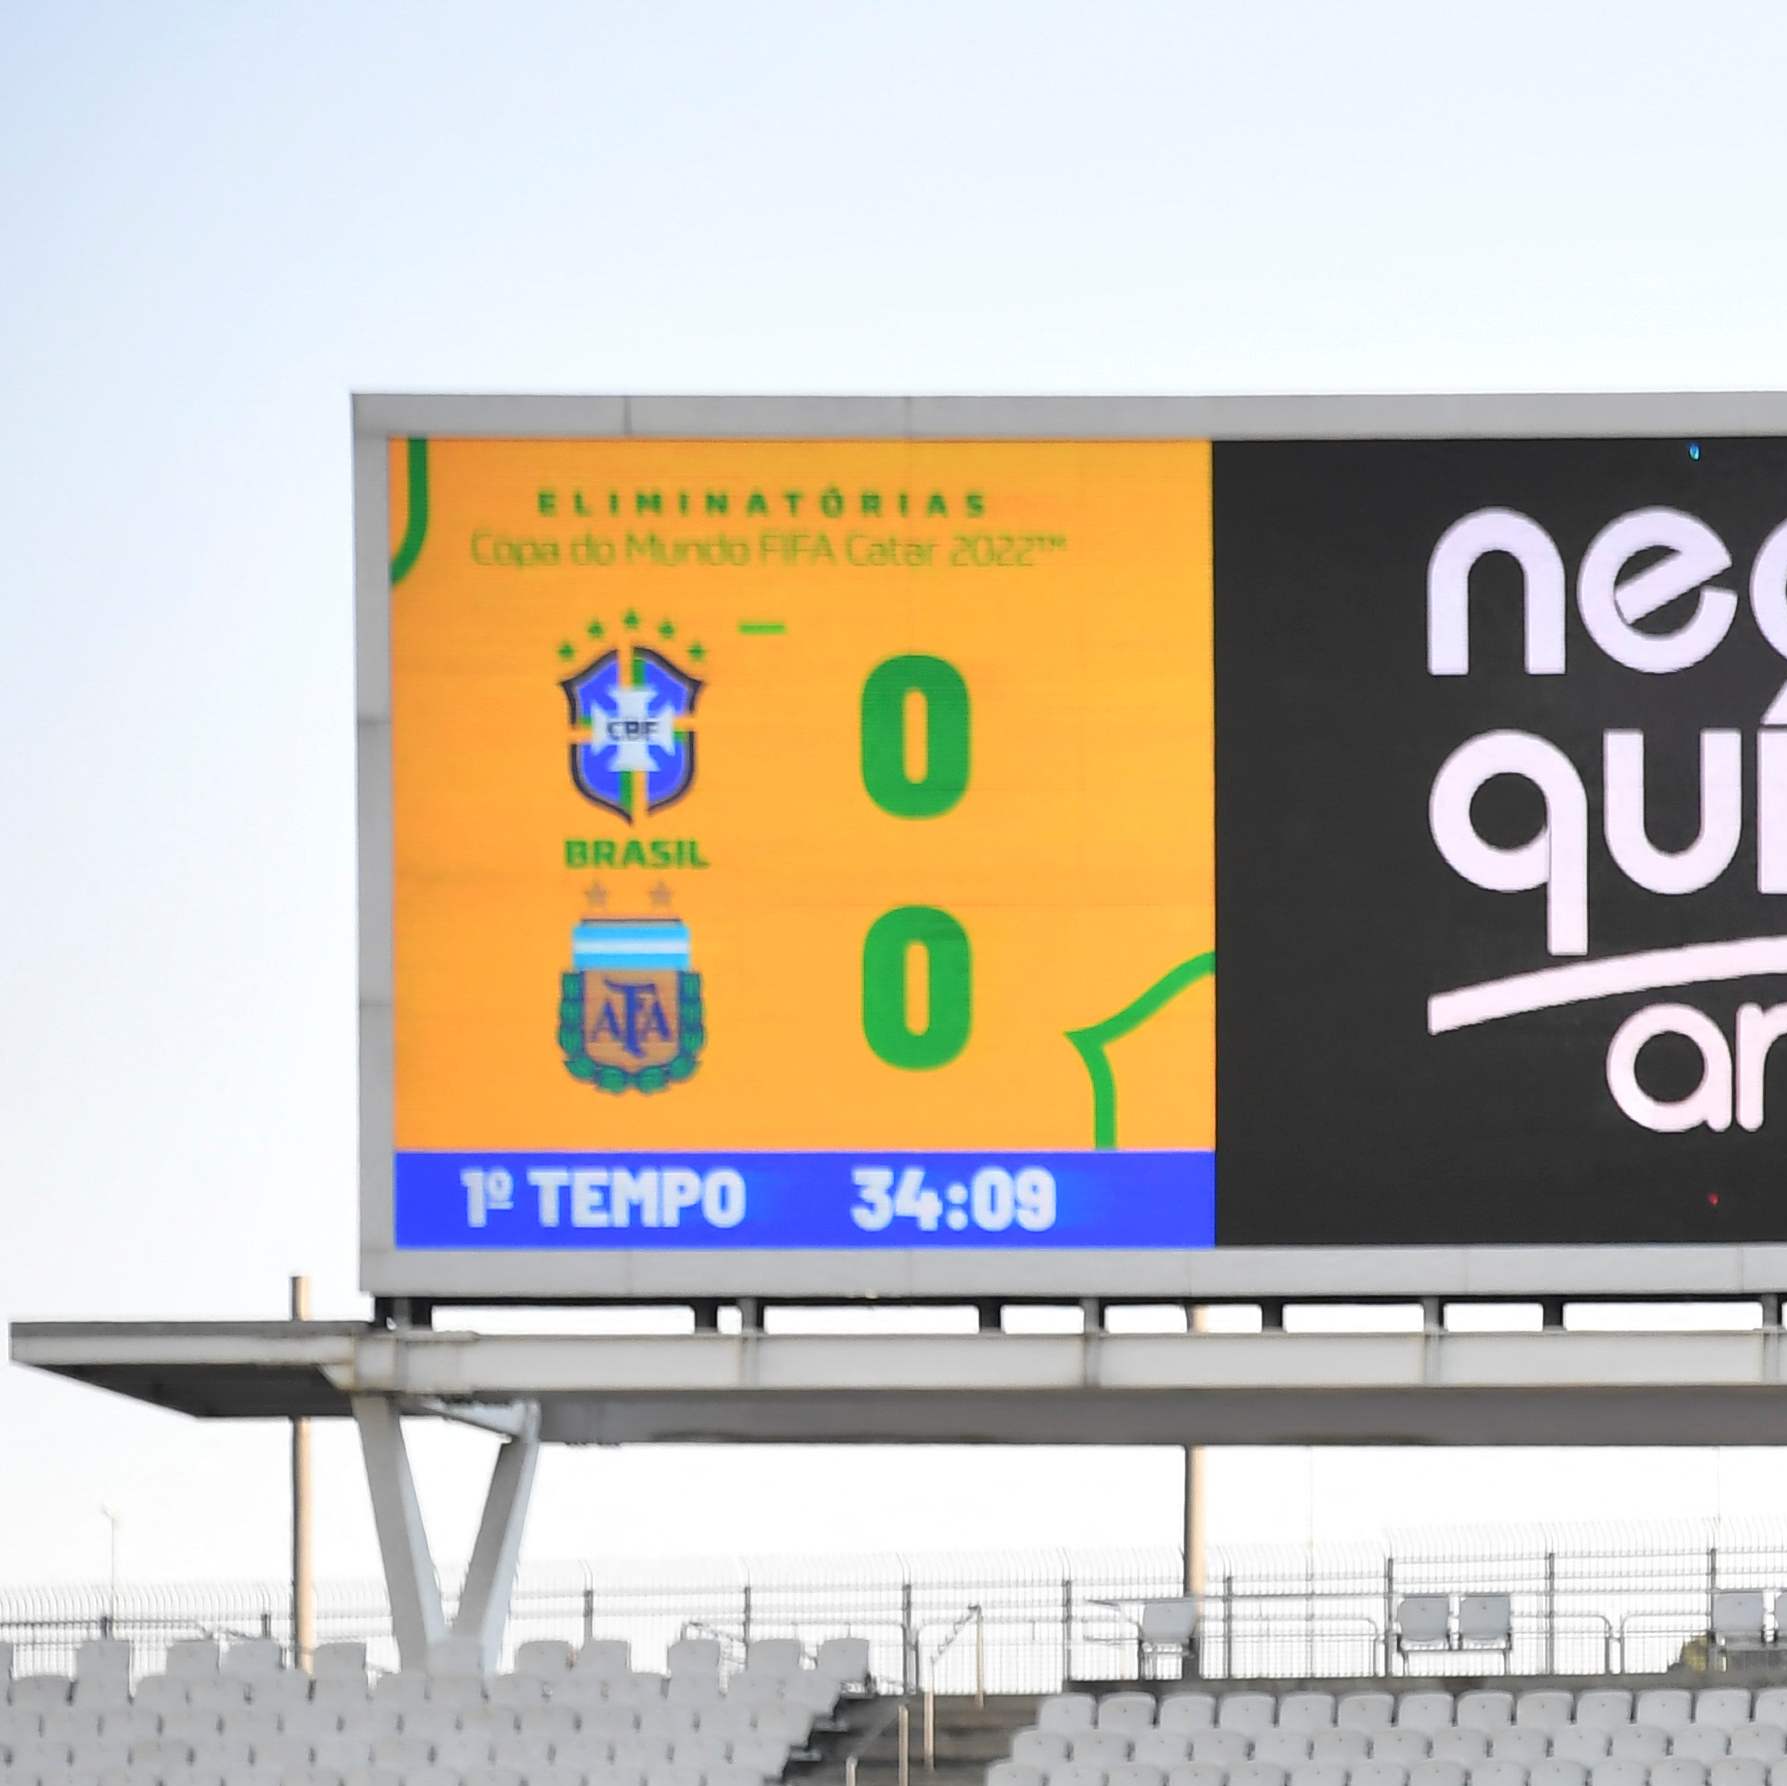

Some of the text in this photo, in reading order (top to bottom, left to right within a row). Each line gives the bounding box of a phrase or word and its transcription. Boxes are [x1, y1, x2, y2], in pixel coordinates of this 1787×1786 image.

[537, 488, 986, 518] ELIMINATÓRIAS
[470, 531, 561, 568] Copa
[570, 531, 616, 567] do
[624, 531, 751, 567] Mundo
[758, 532, 838, 566] FIFA
[845, 531, 936, 566] Catar
[606, 720, 660, 742] CBF
[860, 654, 971, 821] 0
[563, 838, 711, 869] BRASIL
[862, 904, 973, 1071] 0
[527, 1167, 747, 1229] TEMPO
[851, 1165, 1058, 1233] 34:09
